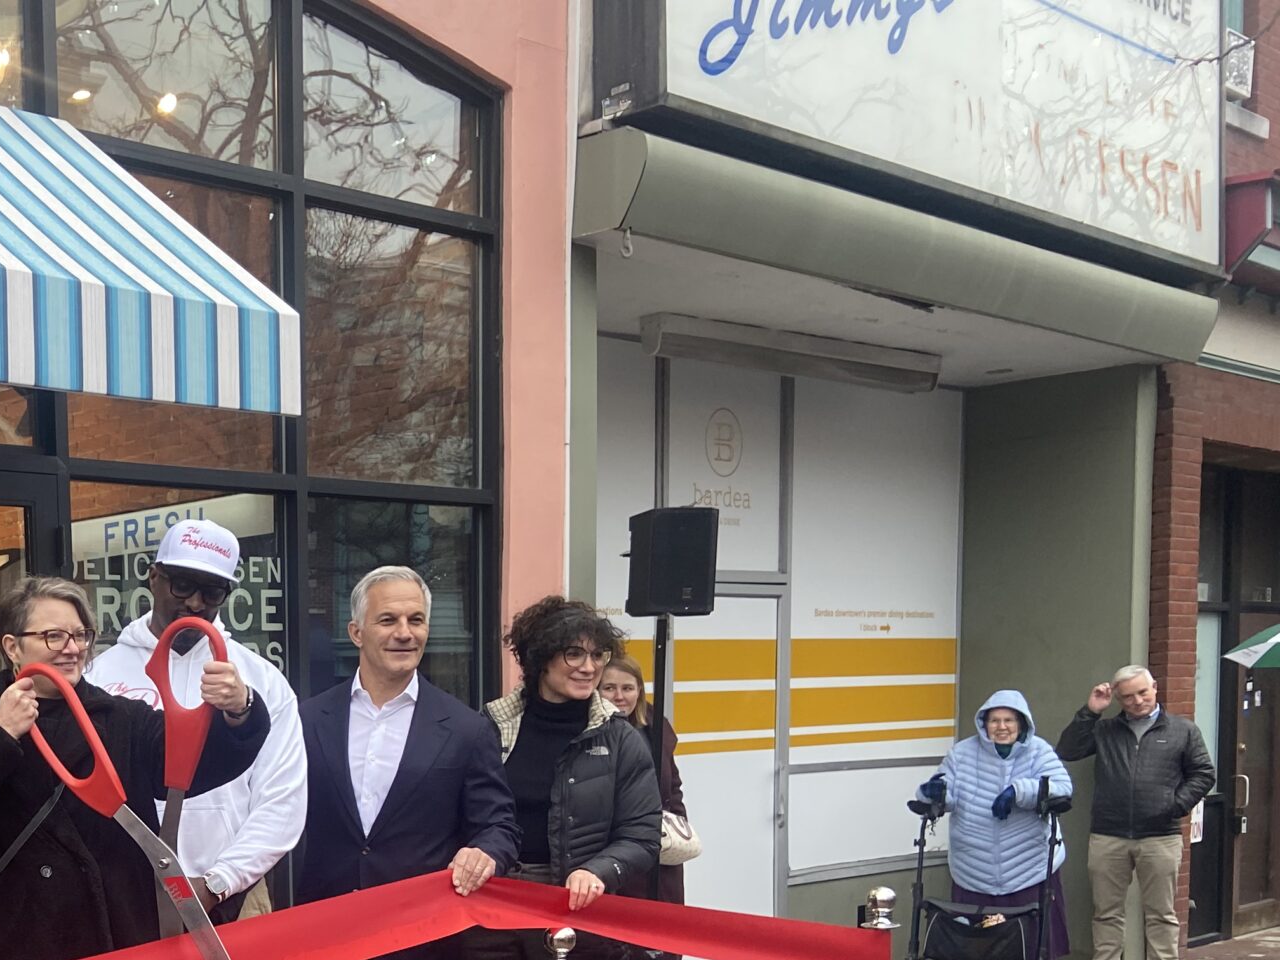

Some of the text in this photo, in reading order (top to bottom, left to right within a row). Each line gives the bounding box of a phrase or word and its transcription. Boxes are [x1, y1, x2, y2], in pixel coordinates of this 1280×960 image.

[692, 482, 751, 509] bardea
[186, 526, 201, 535] The
[180, 533, 232, 560] Professionals
